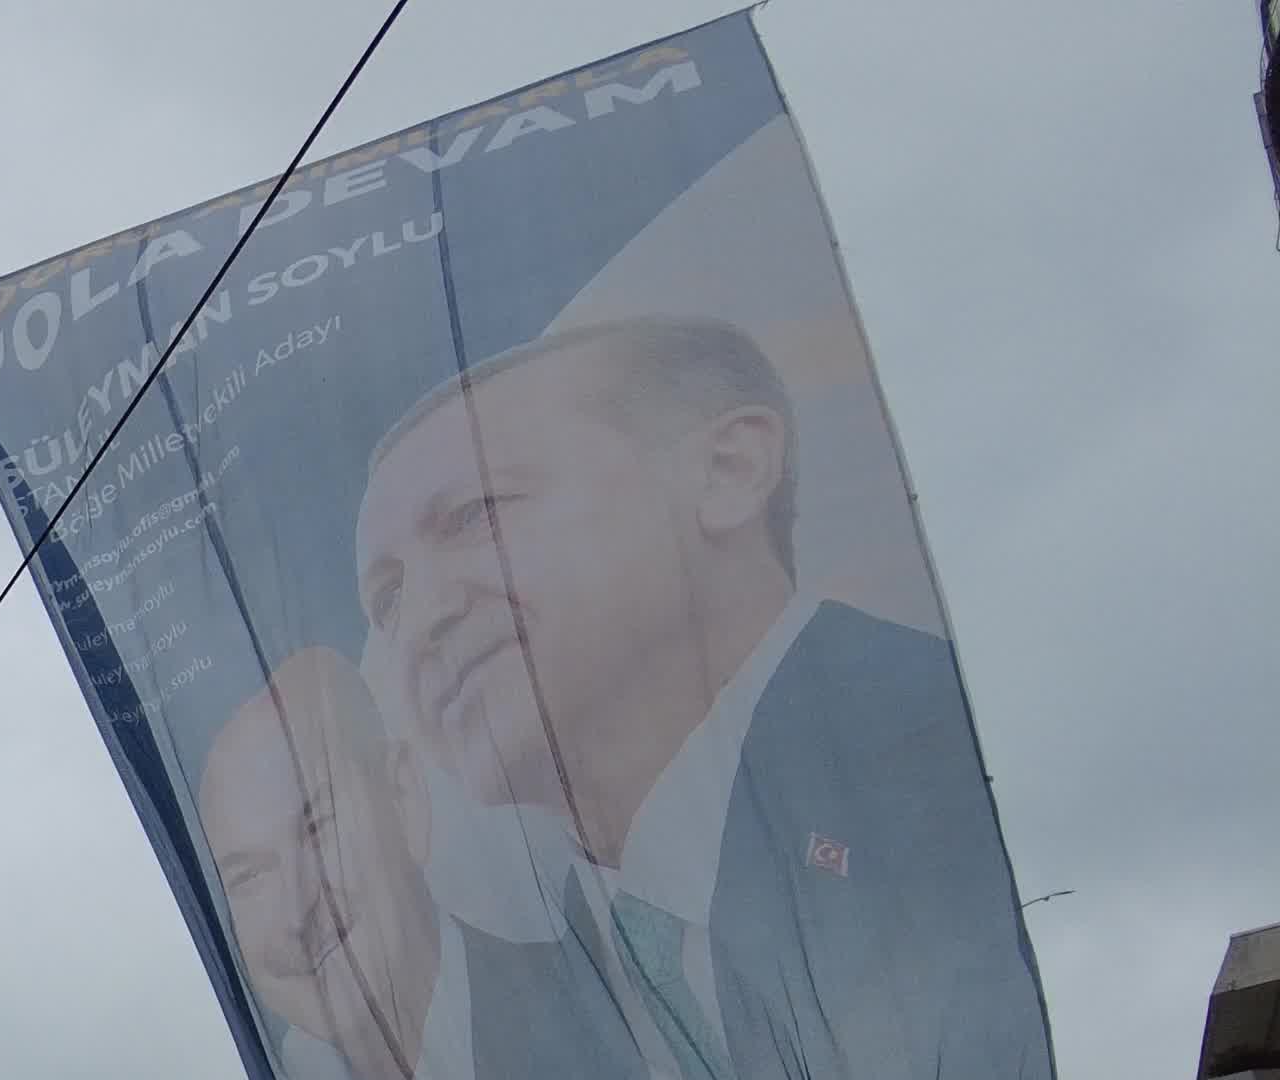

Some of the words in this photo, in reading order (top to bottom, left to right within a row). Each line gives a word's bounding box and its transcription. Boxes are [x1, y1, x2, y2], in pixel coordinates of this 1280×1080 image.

[239, 60, 703, 230] DEVAM
[247, 211, 443, 305] SOYLU
[253, 315, 342, 376] Adayı
